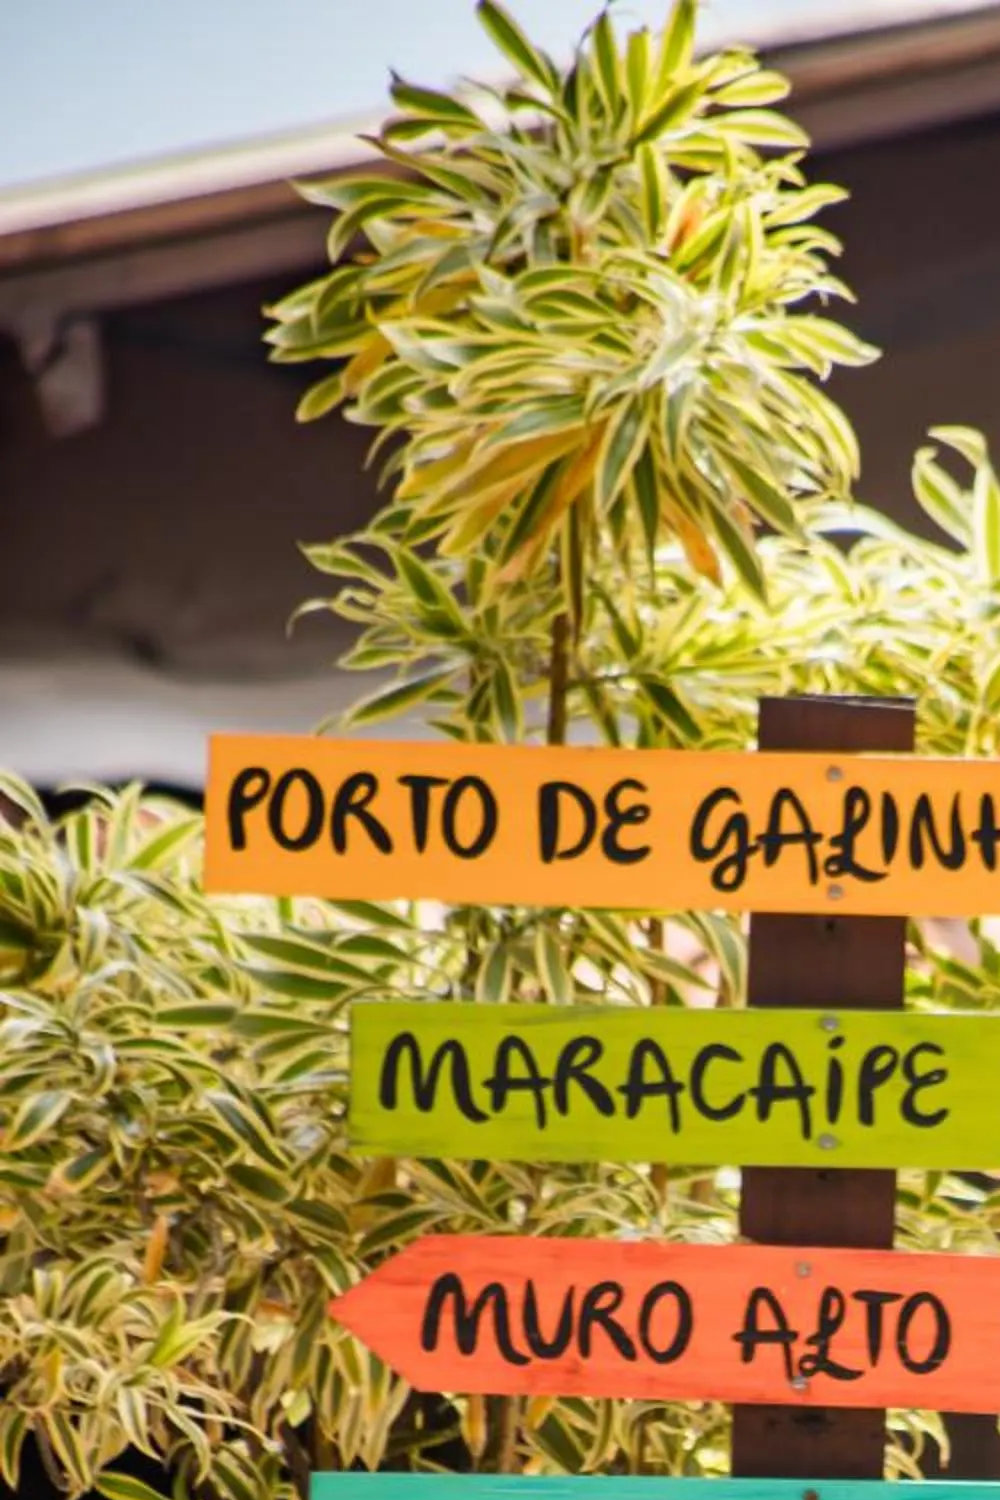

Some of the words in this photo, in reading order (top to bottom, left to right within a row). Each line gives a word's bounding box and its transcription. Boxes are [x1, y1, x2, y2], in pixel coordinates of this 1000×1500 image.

[227, 766, 499, 860] PORTO
[538, 778, 651, 865] DE
[421, 1272, 694, 1366] MURO
[734, 1286, 951, 1382] ALTO
